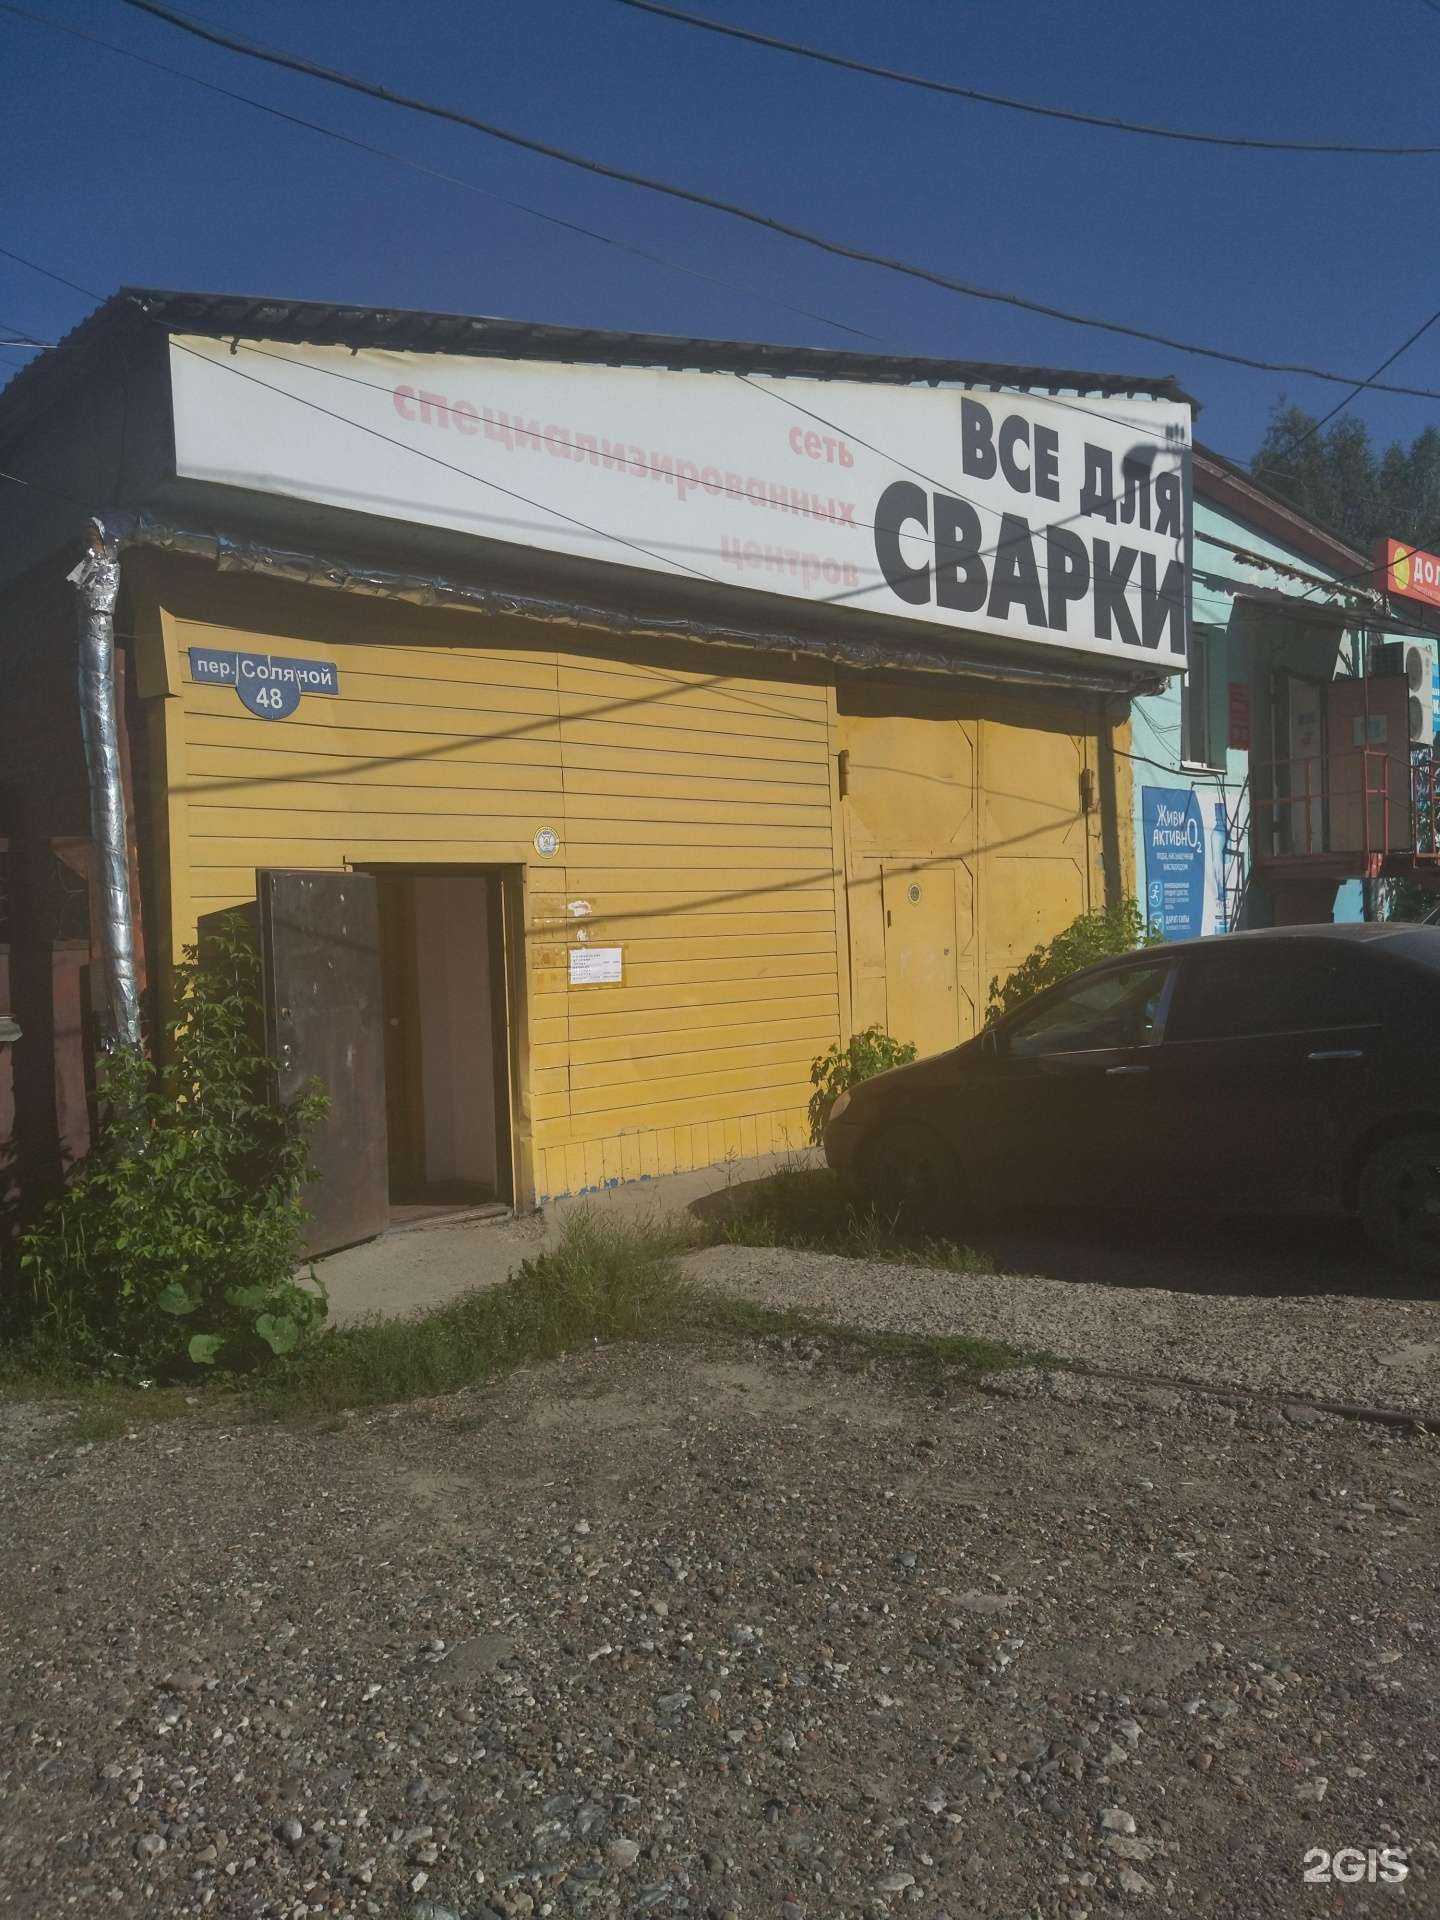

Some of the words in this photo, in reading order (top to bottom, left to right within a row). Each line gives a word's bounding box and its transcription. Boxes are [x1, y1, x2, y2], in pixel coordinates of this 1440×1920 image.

[393, 385, 857, 529] специализированных
[788, 426, 855, 468] сеть
[961, 397, 1060, 502] ВСЕ
[1079, 442, 1181, 539] ДЛЯ
[720, 534, 858, 590] центров
[874, 480, 1186, 656] СВАРКИ
[197, 659, 235, 677] пер.
[241, 660, 332, 685] Соляной
[256, 687, 283, 709] 48
